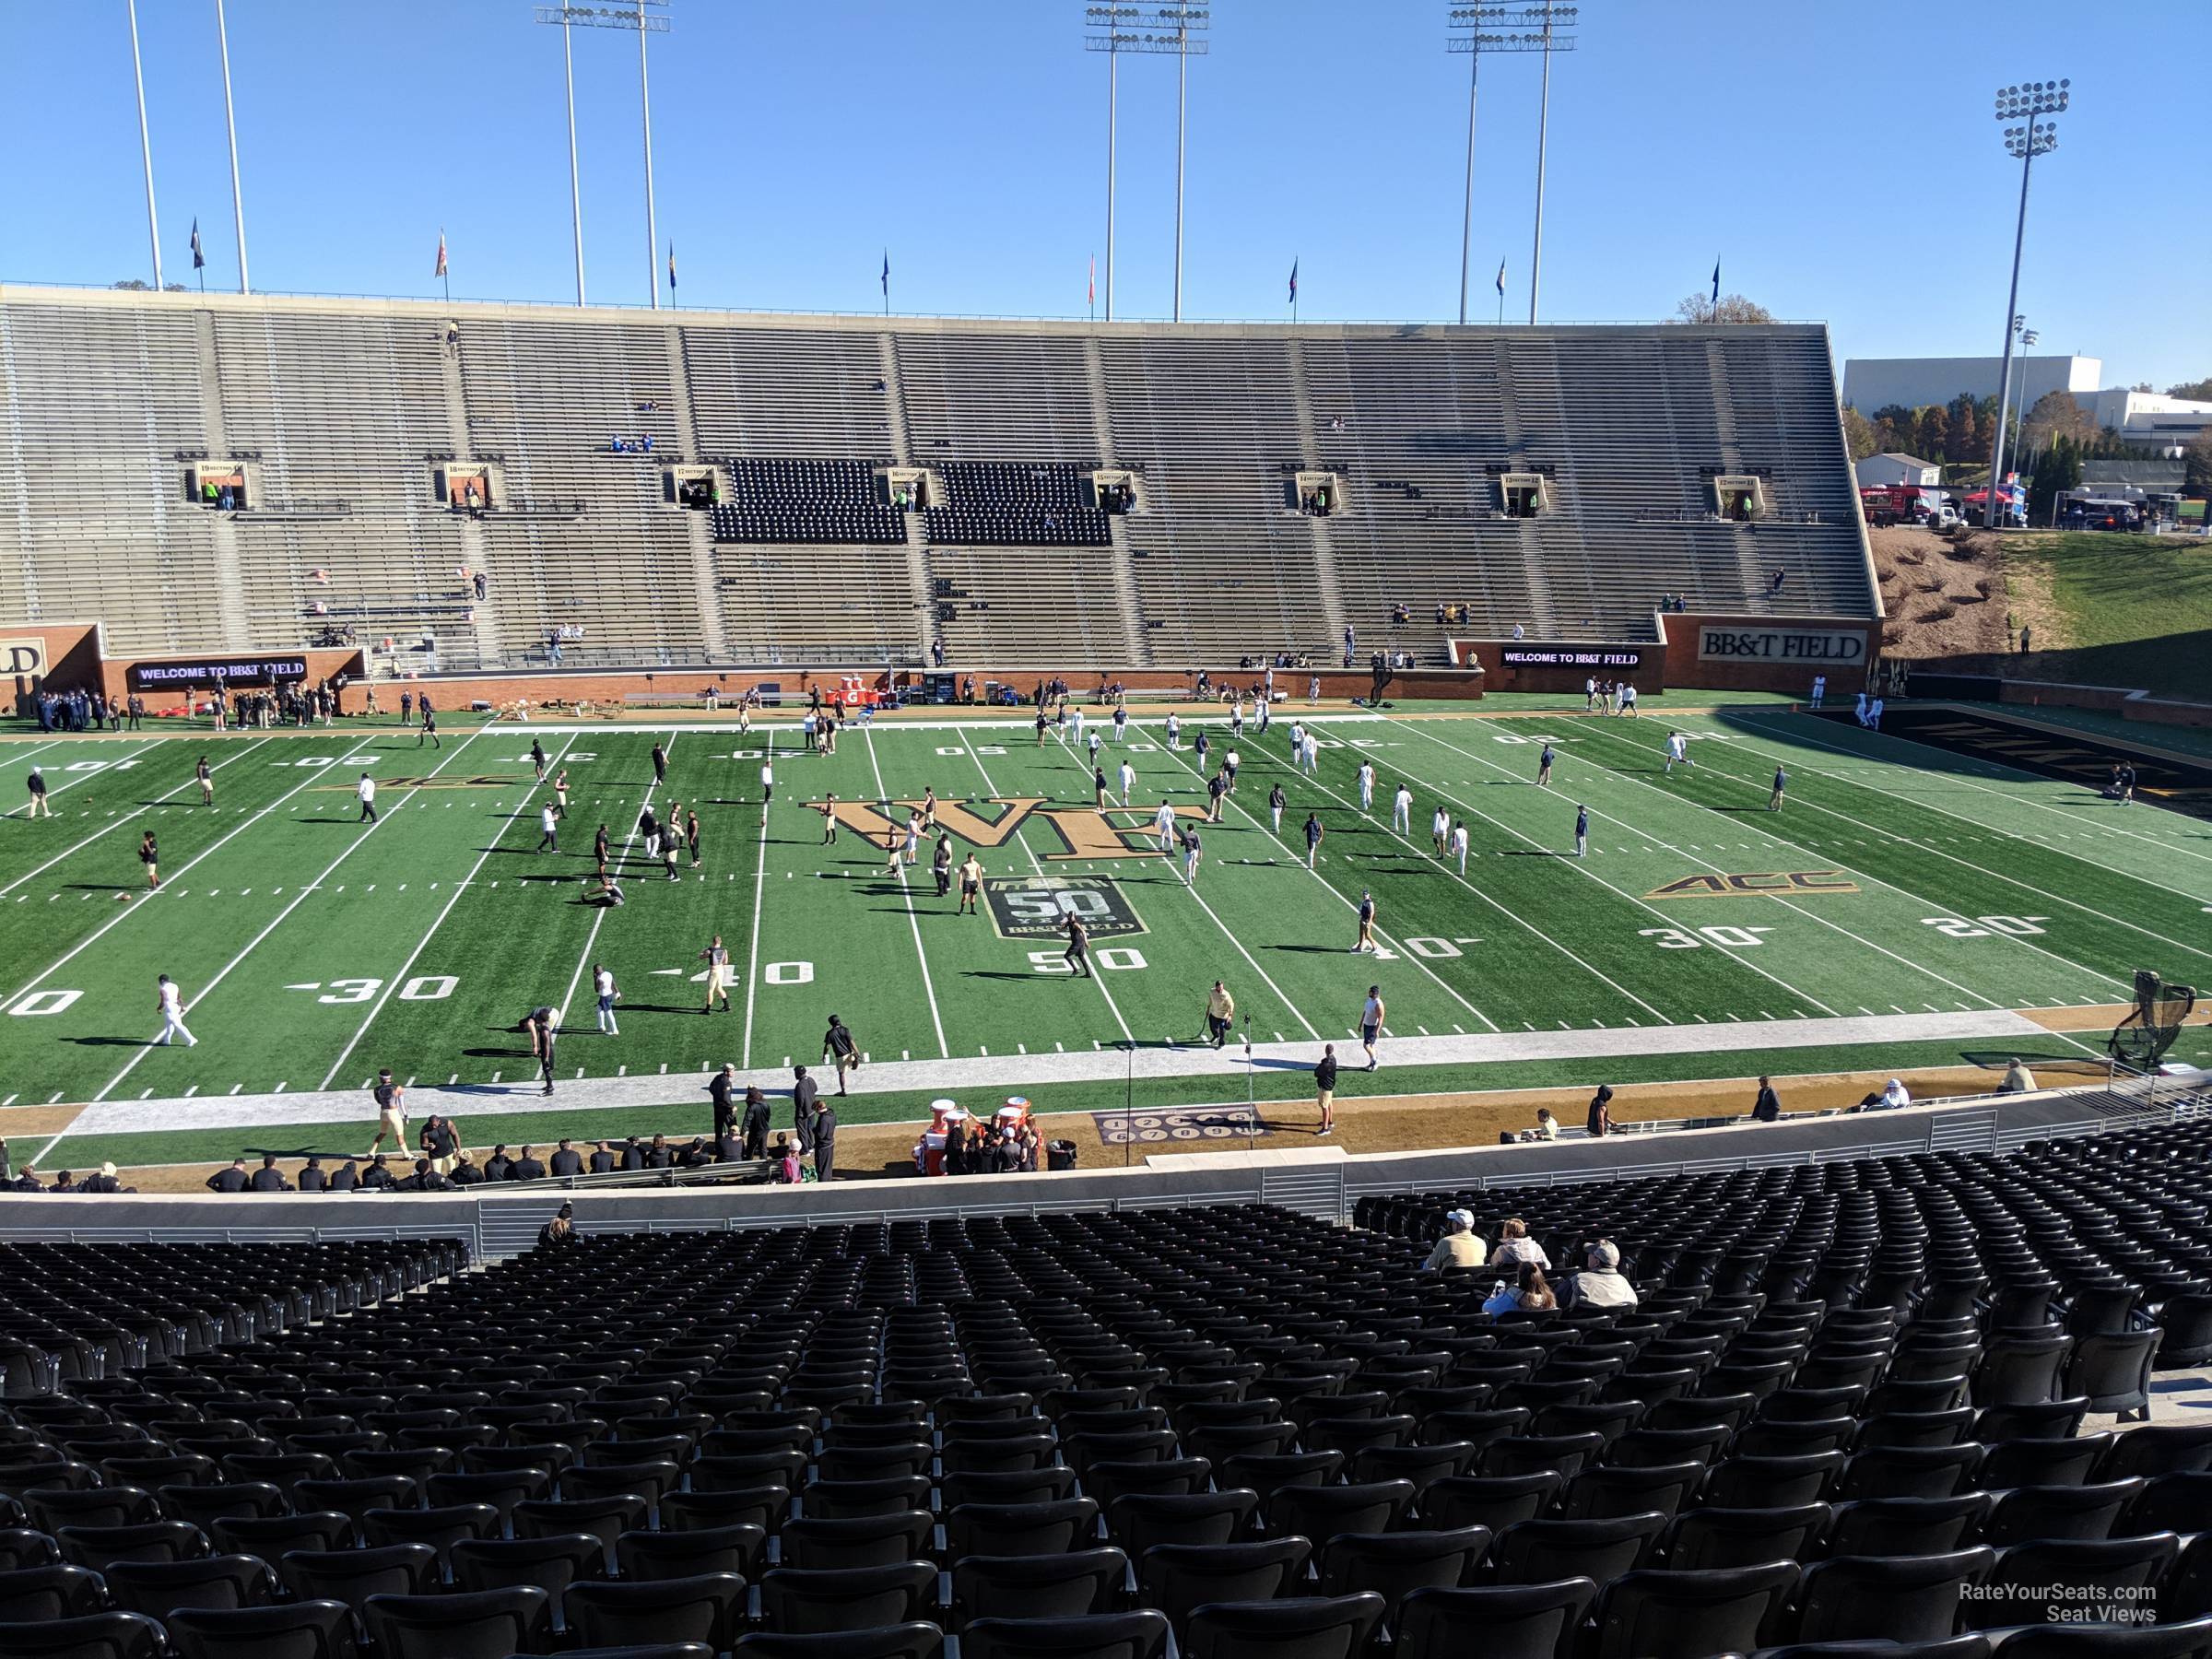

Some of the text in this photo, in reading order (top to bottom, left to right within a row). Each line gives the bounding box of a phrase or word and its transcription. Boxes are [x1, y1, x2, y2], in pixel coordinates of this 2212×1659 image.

[1704, 632, 1862, 659] BB&T FIELD
[1504, 653, 1639, 665] WELCOME TO BB&T FIELD
[140, 667, 206, 680] WELCOME
[208, 666, 228, 677] TO
[229, 665, 260, 677] BB&T
[1645, 870, 1860, 897] ACC
[1004, 889, 1112, 918] 50
[1017, 915, 1118, 924] YERS
[1072, 923, 1135, 933] IELD
